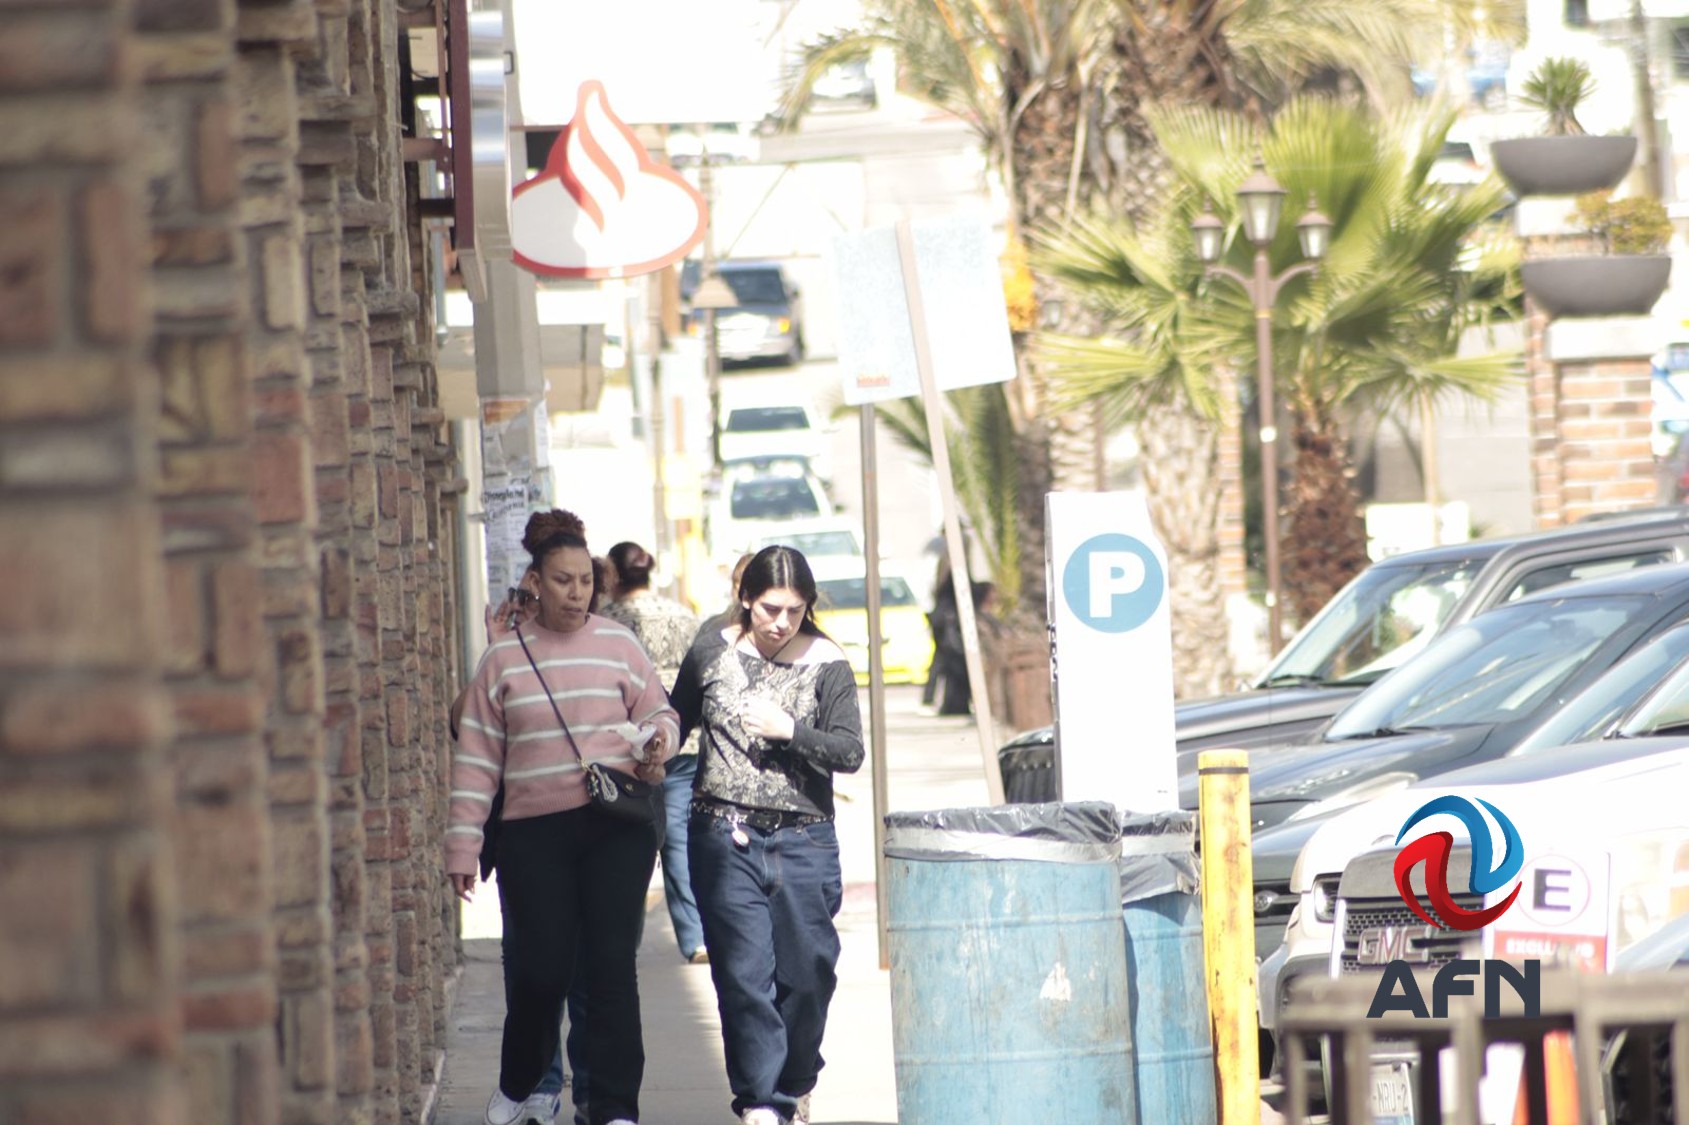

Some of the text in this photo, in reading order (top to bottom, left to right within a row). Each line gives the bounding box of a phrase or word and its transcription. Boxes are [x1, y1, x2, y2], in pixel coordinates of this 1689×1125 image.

[1089, 551, 1145, 618] P
[1533, 868, 1572, 912] E
[1357, 925, 1433, 965] GMC
